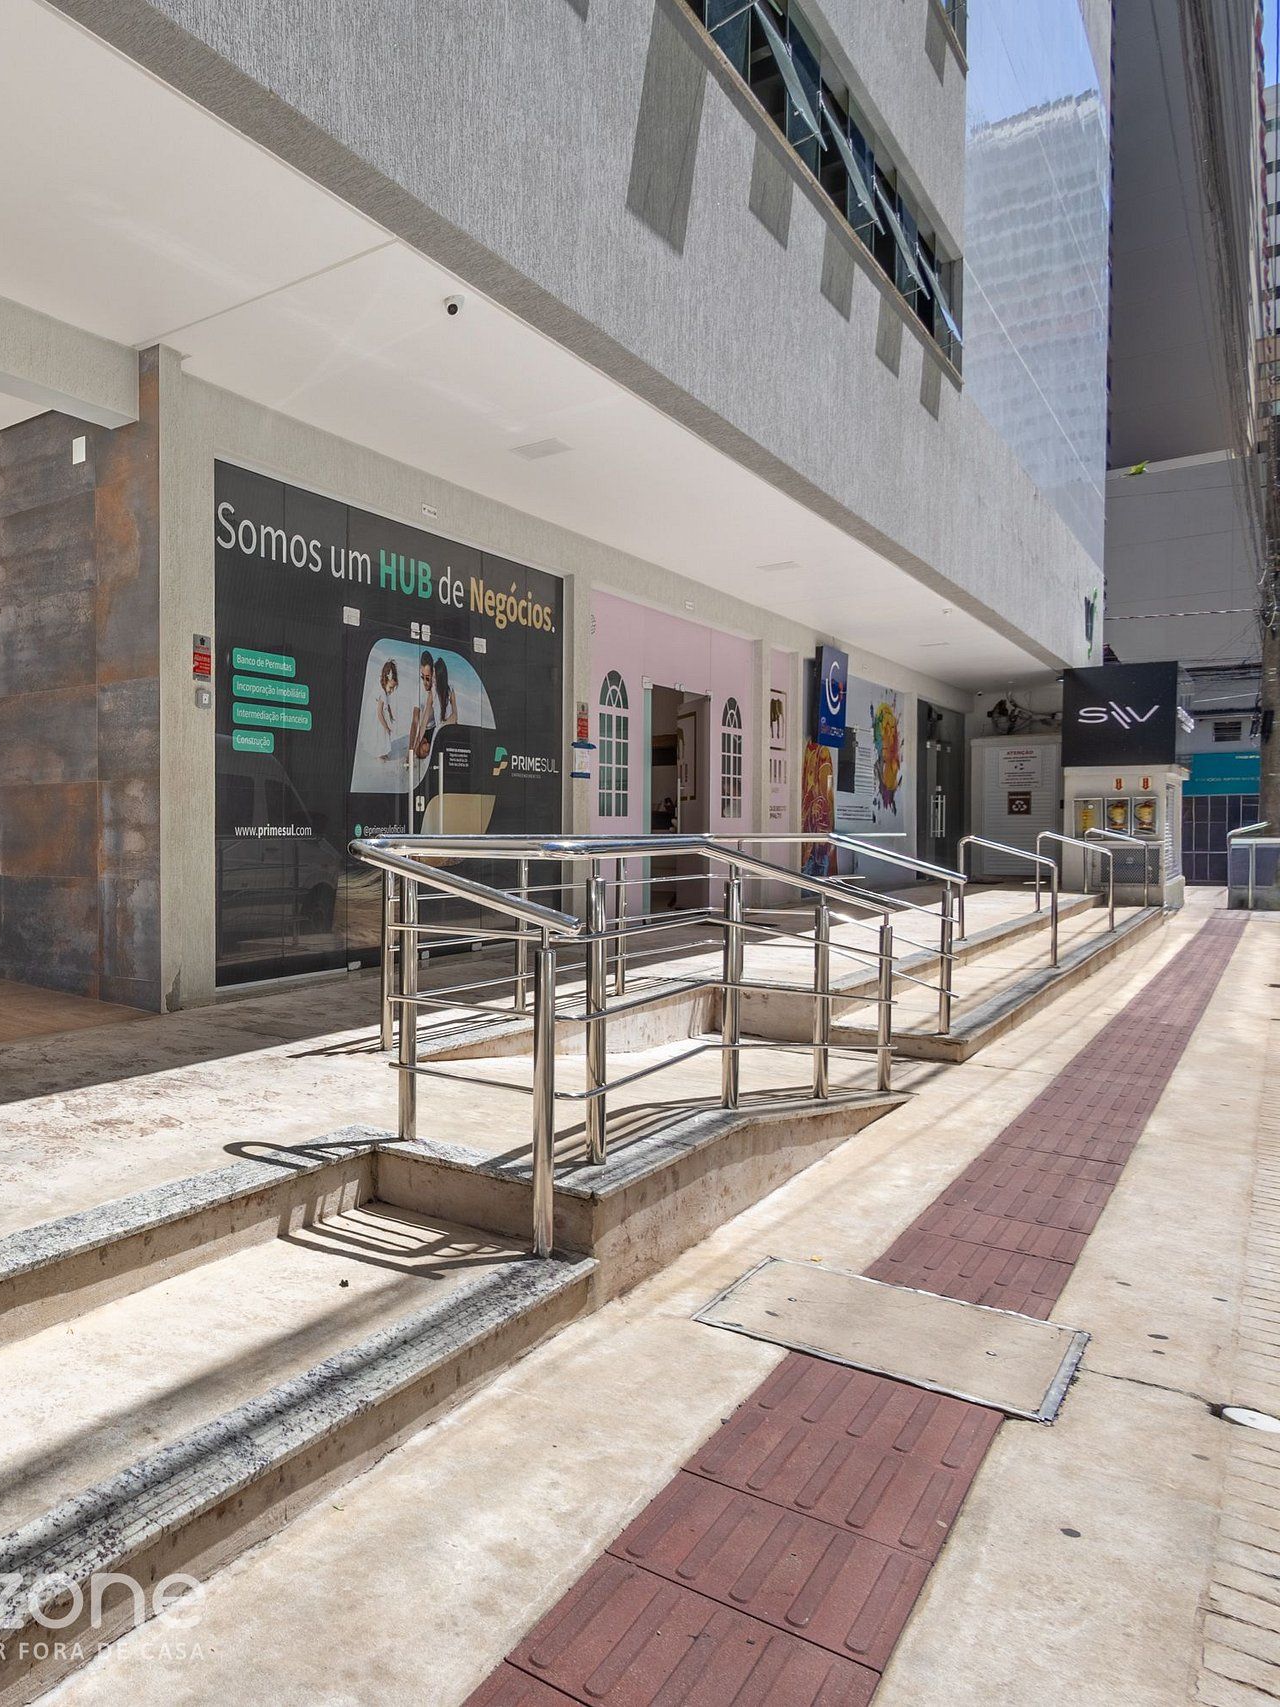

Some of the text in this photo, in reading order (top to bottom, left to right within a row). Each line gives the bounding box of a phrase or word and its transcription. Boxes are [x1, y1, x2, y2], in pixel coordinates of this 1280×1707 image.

[216, 501, 322, 573] Somos
[330, 545, 371, 585] um
[379, 549, 433, 599] HUB
[438, 566, 465, 609] de
[470, 576, 556, 634] Negócios.
[236, 654, 292, 672] Banco de Permutas
[236, 682, 306, 699] Incorporação Imobiliária
[236, 708, 308, 725] Intermediação Financeira
[236, 734, 271, 748] Construção
[511, 755, 559, 774] PRIMESUL
[234, 823, 312, 839] www.primesul.com
